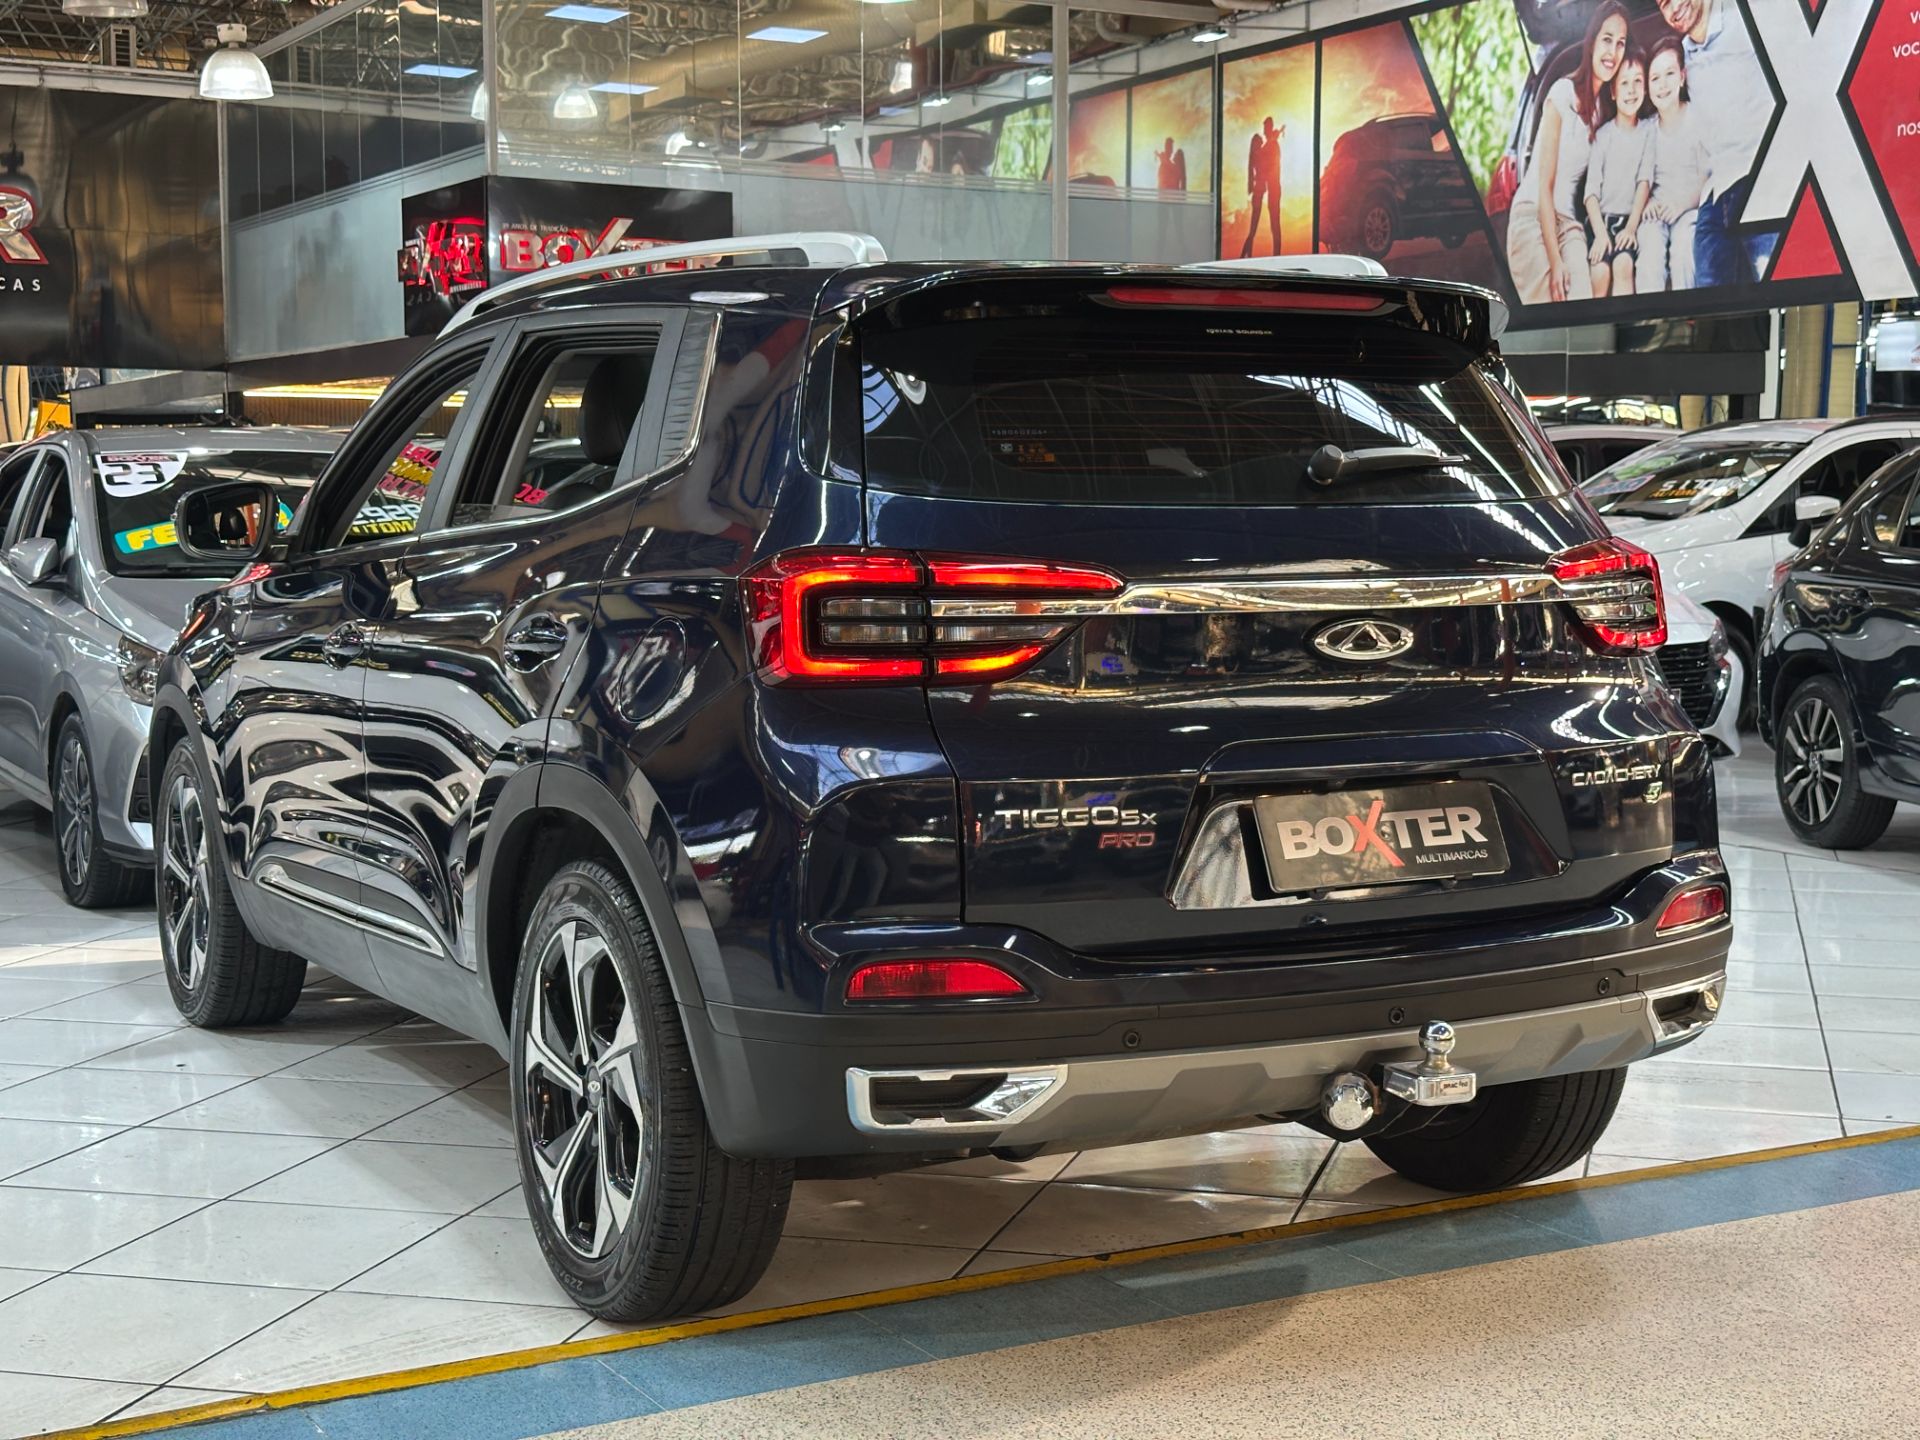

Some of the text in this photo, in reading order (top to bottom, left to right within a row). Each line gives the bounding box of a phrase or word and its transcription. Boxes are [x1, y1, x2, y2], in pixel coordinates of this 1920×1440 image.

[1100, 832, 1155, 849] PRO
[1276, 799, 1489, 868] BOXTER
[1415, 849, 1488, 864] MULTIMARCAS
